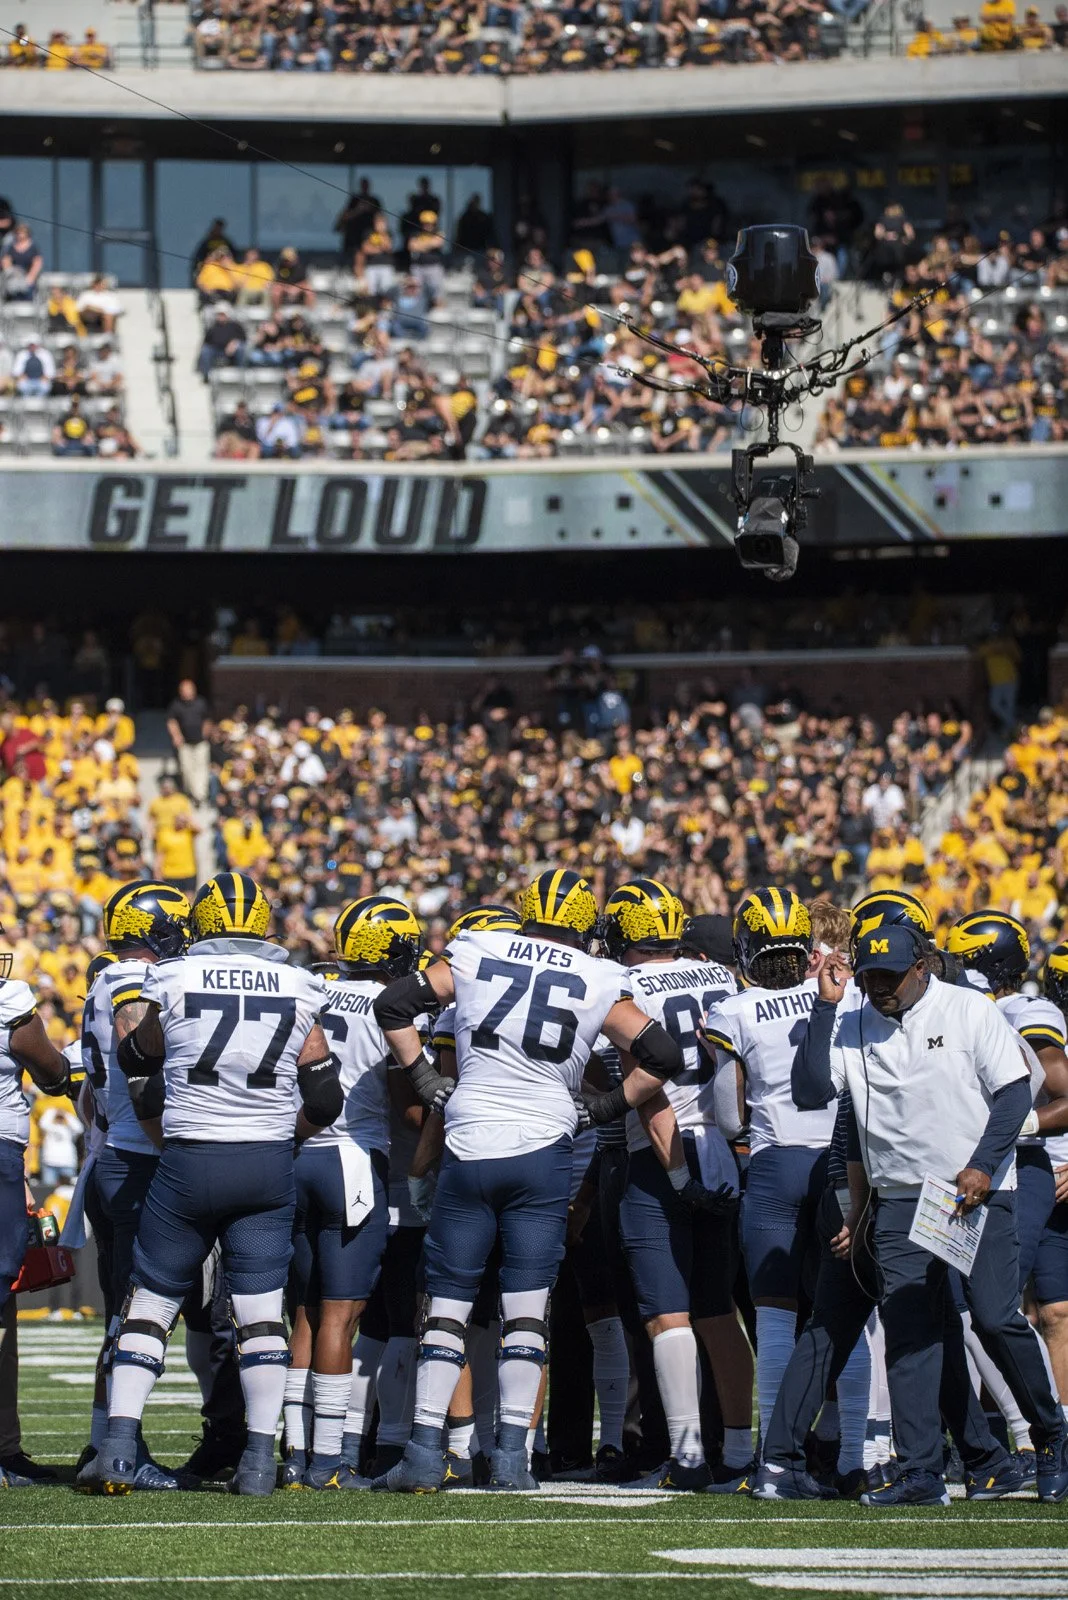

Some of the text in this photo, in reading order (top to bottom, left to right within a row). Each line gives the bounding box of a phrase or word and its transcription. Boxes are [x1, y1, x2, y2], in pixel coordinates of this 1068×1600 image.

[89, 475, 487, 552] GET LOUD
[507, 942, 573, 968] HAYES
[870, 938, 889, 953] M
[203, 969, 280, 993] KEEGAN
[637, 965, 732, 996] SCHOONMAKER
[470, 957, 588, 1065] 76
[755, 990, 819, 1023] ANTHO
[184, 992, 296, 1089] 77
[928, 1036, 943, 1049] M
